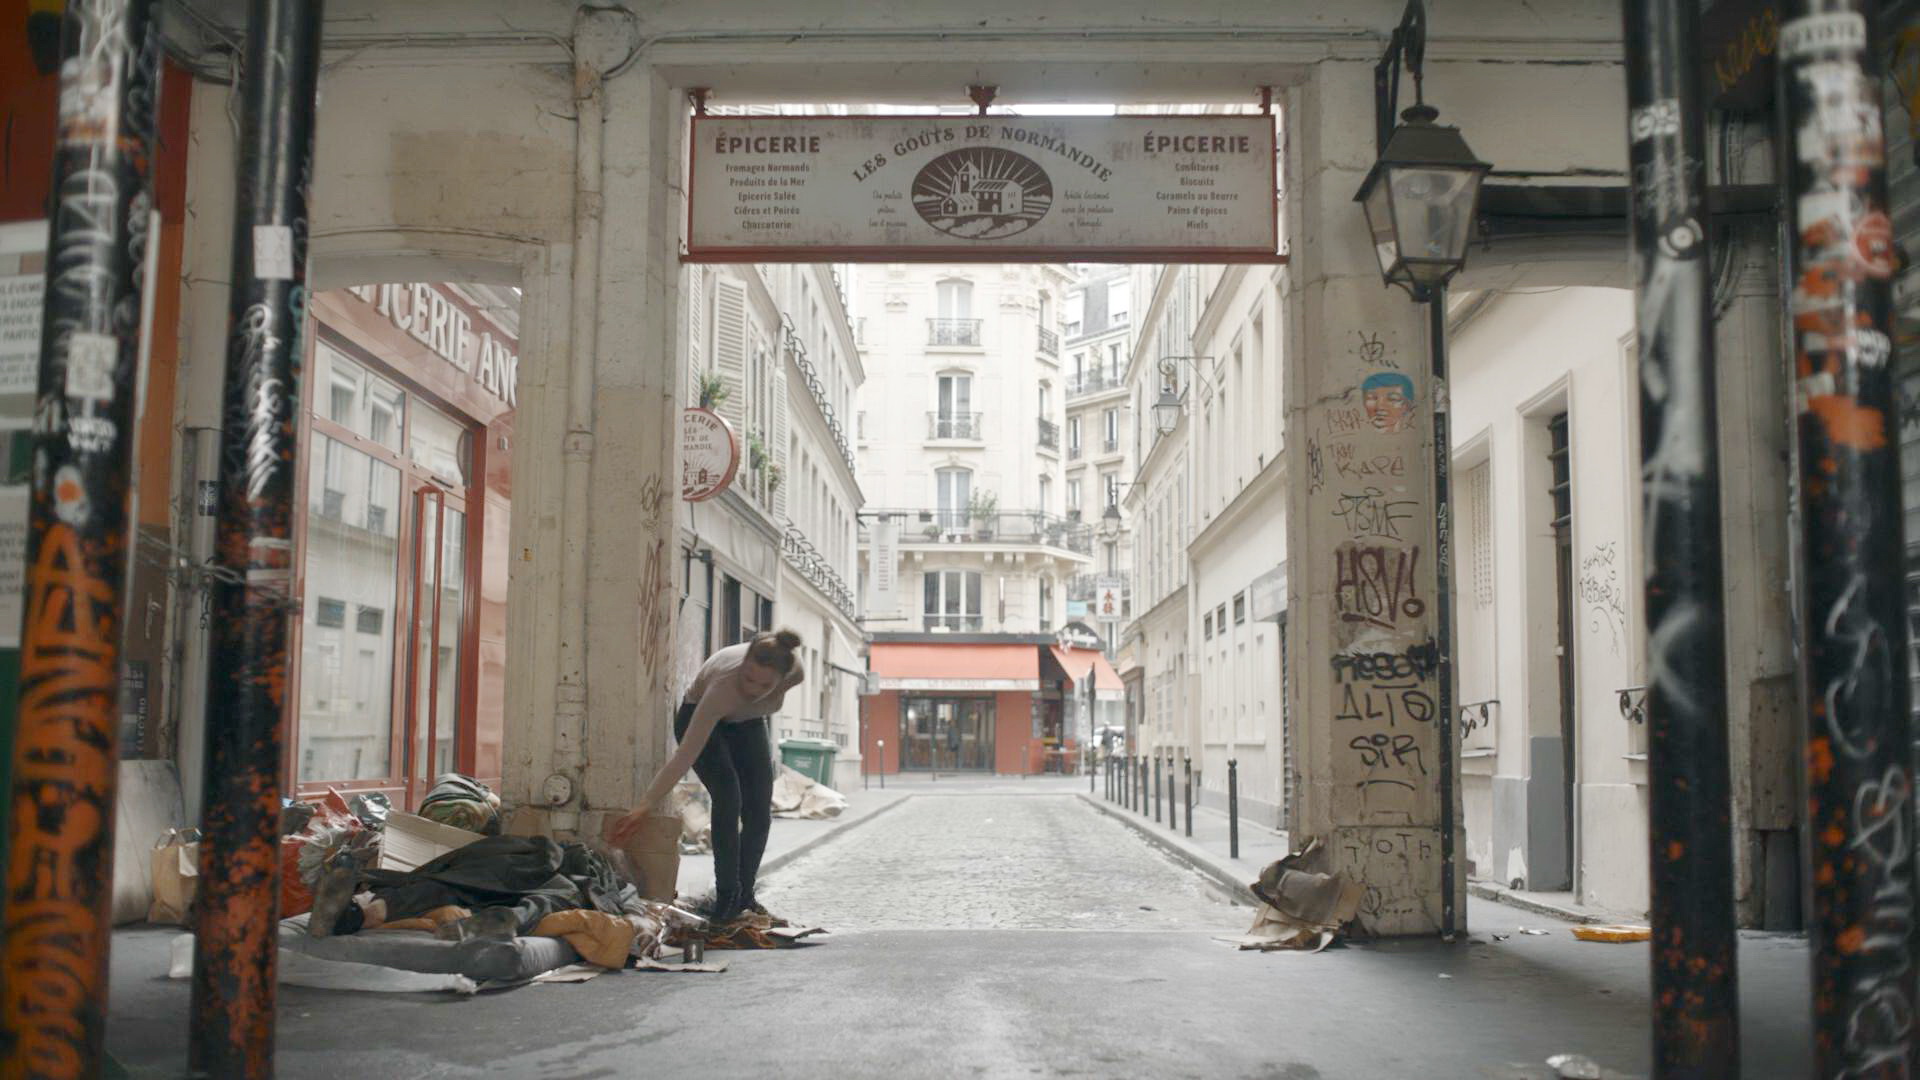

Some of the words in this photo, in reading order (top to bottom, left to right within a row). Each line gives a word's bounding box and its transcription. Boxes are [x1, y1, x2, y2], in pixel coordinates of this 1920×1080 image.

[715, 130, 821, 154] ÉPICERIE
[1143, 130, 1249, 153] ÉPICERIE
[853, 153, 887, 182] LES
[965, 125, 990, 139] DE
[1001, 126, 1112, 182] NORMANDIE
[725, 164, 765, 174] Fromages
[767, 163, 810, 172] Normands
[1175, 162, 1219, 172] Confitures
[729, 178, 765, 187] Produits
[768, 178, 778, 187] de
[780, 178, 788, 187] la
[790, 178, 805, 187] Mer
[1180, 177, 1215, 187] Biscuits
[1156, 191, 1196, 201] Caramels
[1197, 193, 1208, 201] au
[1210, 192, 1239, 201] Beurre
[734, 206, 761, 215] Cidres
[763, 206, 771, 215] et
[1167, 206, 1191, 215] Pains
[1185, 220, 1209, 229] Miels
[349, 282, 472, 374] ICERIE
